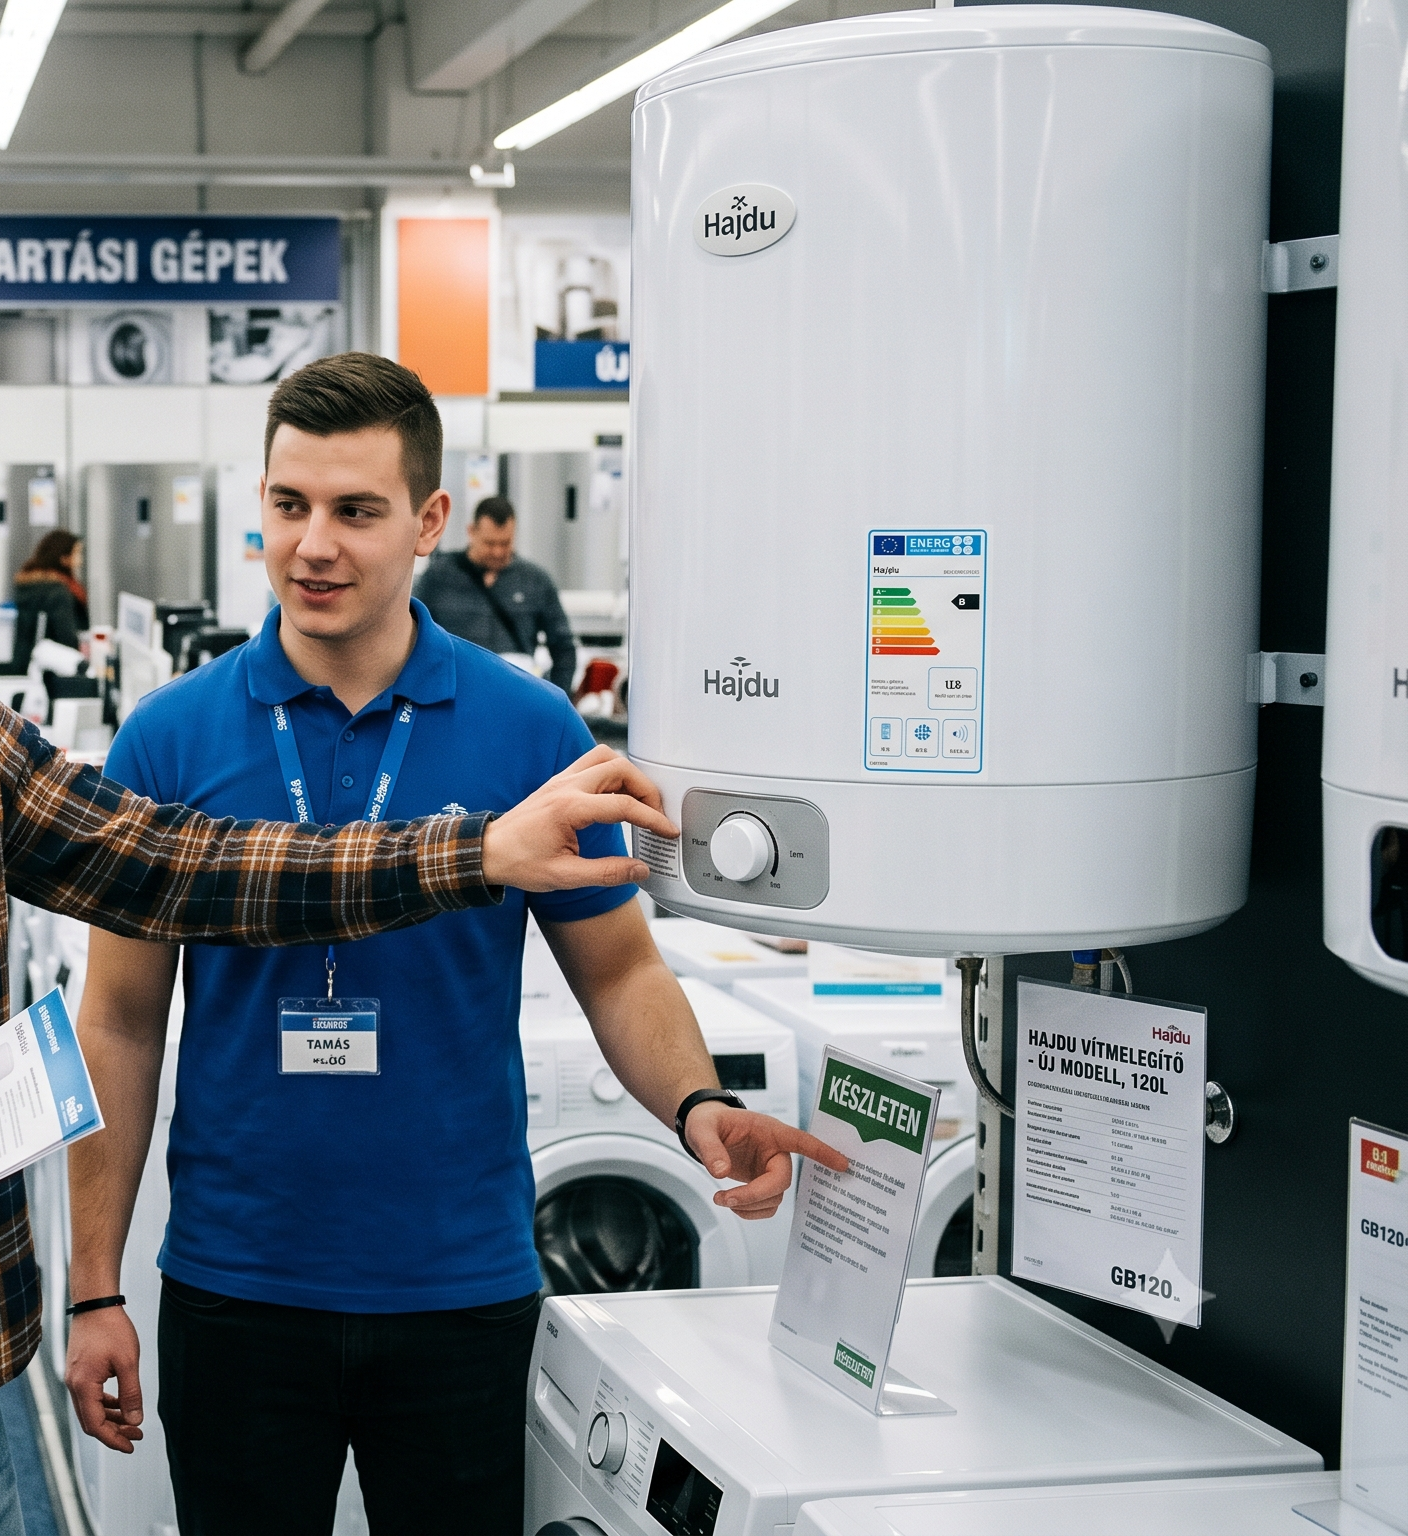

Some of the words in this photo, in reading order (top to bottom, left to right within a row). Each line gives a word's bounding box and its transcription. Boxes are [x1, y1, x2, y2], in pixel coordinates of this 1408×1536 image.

[704, 204, 776, 241] Hajdu
[150, 229, 290, 285] GÉPEK
[909, 537, 951, 549] ENERG
[958, 597, 966, 606] B
[704, 668, 779, 702] Hajdu
[306, 1037, 350, 1050] TAMÁS
[1028, 1028, 1077, 1054] HAJDU
[1081, 1036, 1185, 1075] VÍTMELEGÍTŐ
[1151, 1026, 1191, 1045] Hajdu
[1038, 1050, 1055, 1073] ÚJ
[1060, 1058, 1126, 1090] MODELL,
[1131, 1072, 1169, 1096] 120L
[827, 1074, 922, 1138] KÉSZLETEN
[1110, 1265, 1173, 1300] GB120
